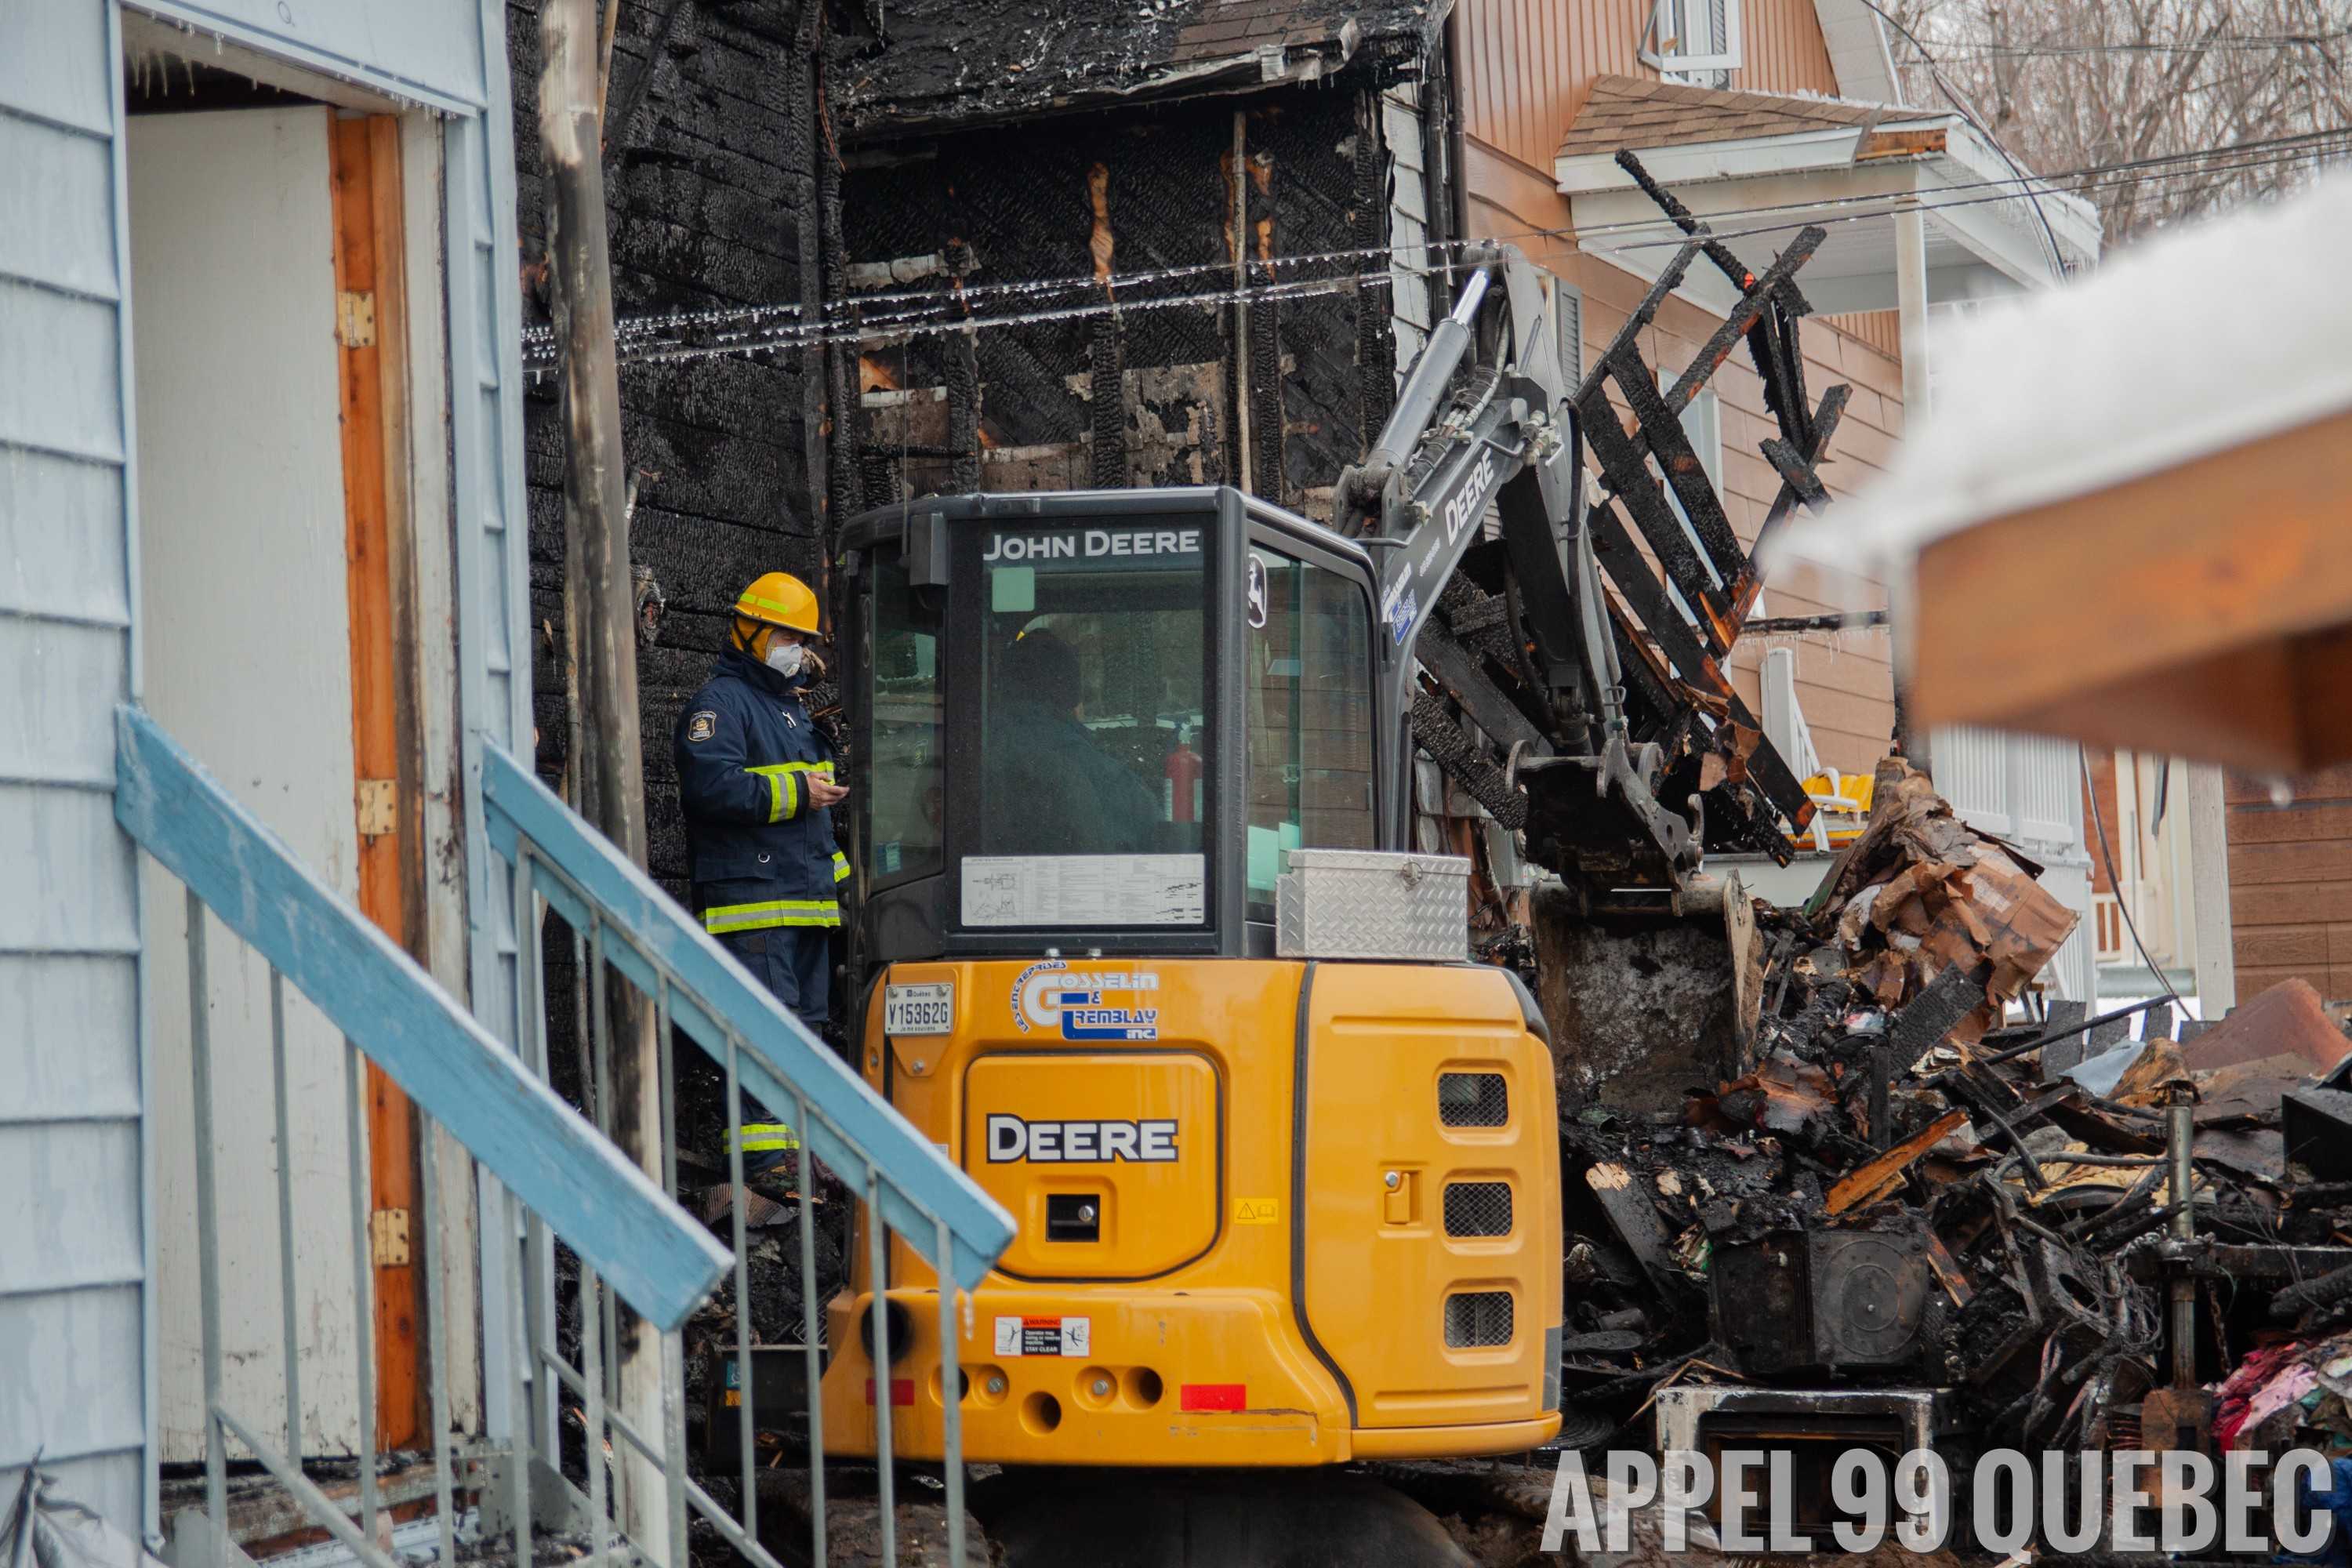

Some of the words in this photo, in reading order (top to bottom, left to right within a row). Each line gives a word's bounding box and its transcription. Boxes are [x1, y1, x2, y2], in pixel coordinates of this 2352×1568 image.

[1445, 447, 1494, 546] DEERE
[983, 535, 1075, 561] JOHN
[1085, 530, 1200, 557] DEERE
[1091, 991, 1101, 1004] &
[889, 1002, 948, 1025] V15362G
[987, 1114, 1178, 1163] DEERE
